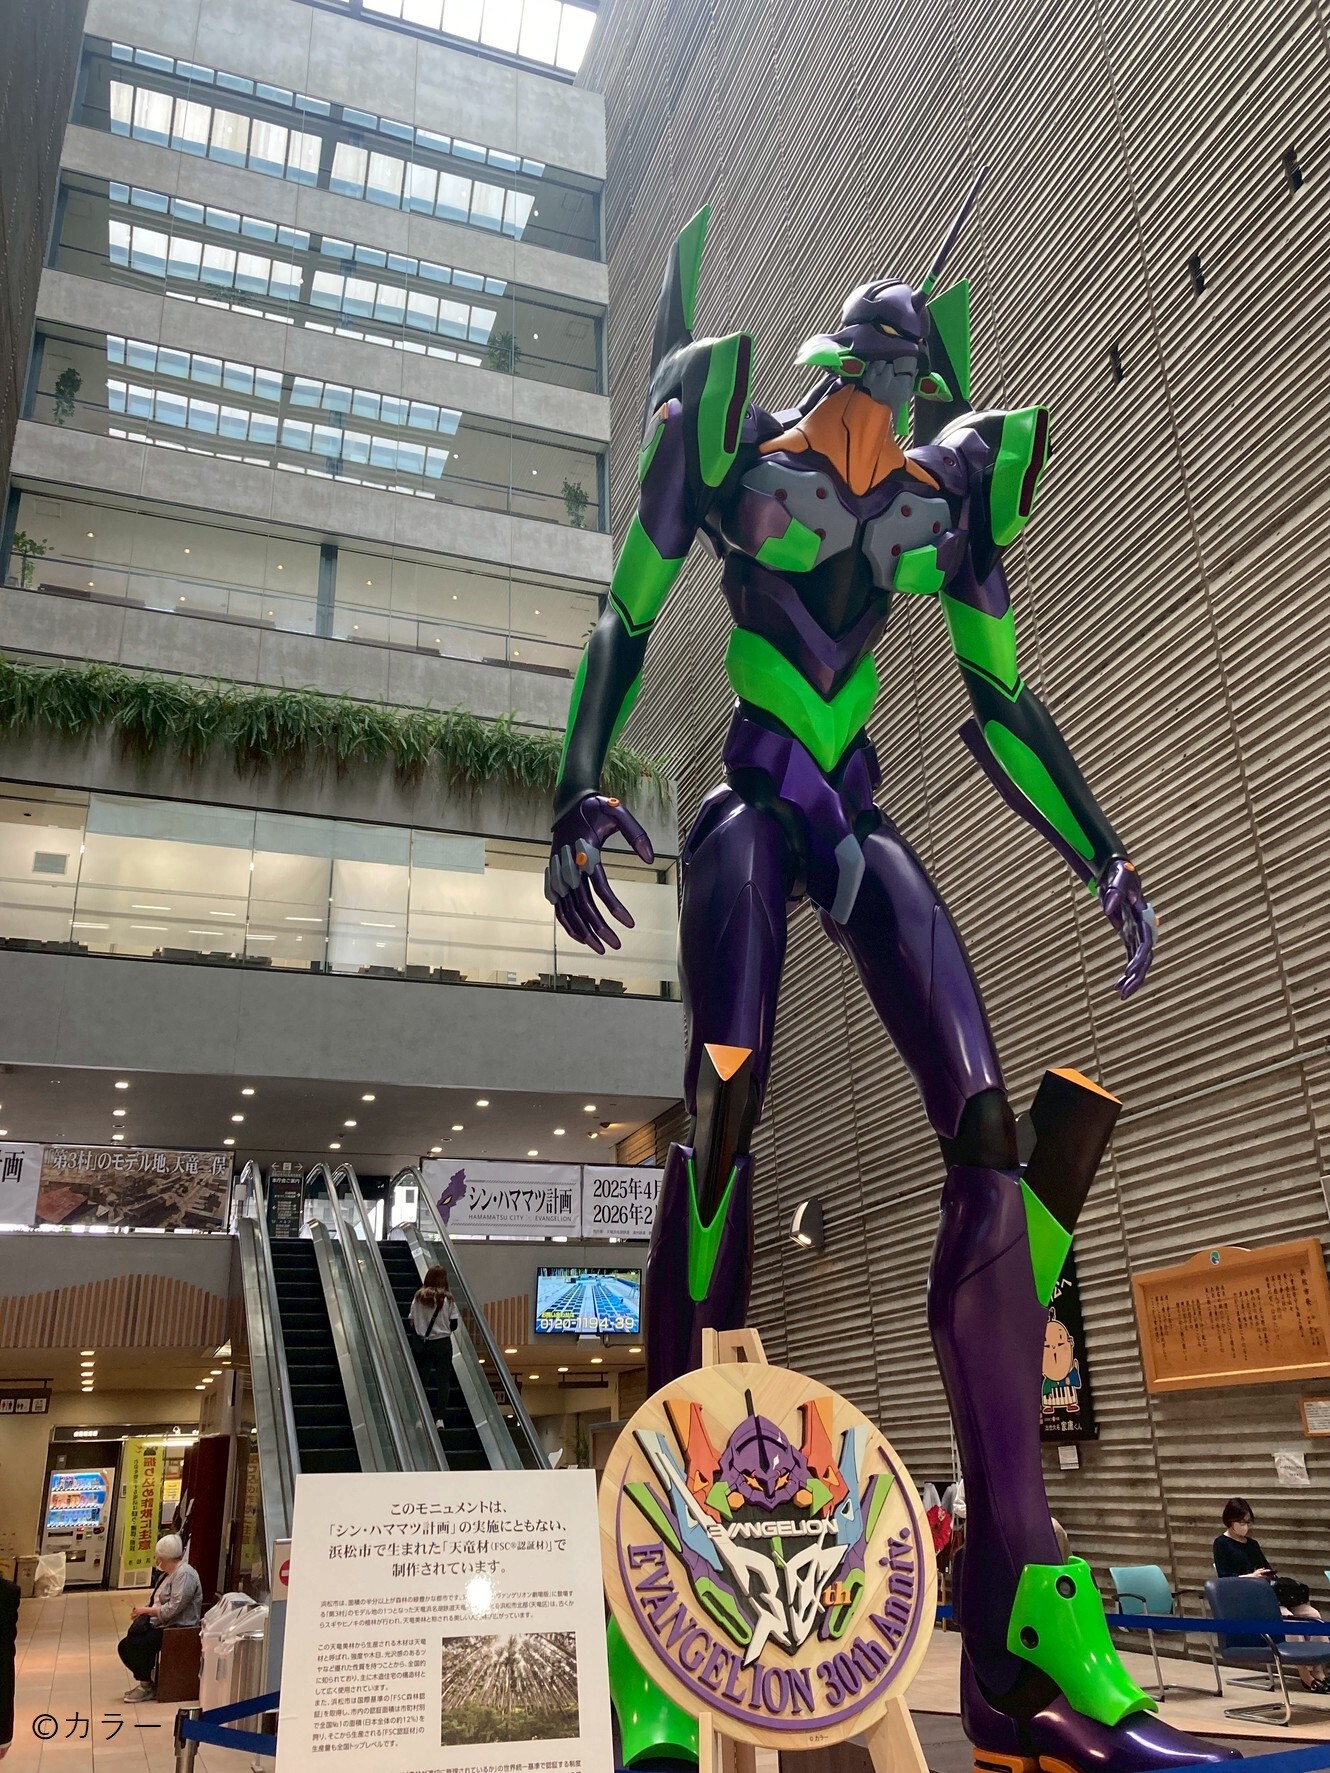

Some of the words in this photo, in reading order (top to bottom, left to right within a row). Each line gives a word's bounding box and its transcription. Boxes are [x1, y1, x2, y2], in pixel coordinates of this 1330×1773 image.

[0, 1149, 25, 1182] 画
[469, 1186, 573, 1214] シン・ハママツ計画
[593, 1203, 658, 1225] 2026年2
[540, 1317, 635, 1330] 0120-1194-39
[391, 1501, 507, 1516] このモニュメントは、
[329, 1519, 567, 1537] 「シン・ハママツ計画」の実施にともない、
[707, 1518, 839, 1539] EVANGELION
[392, 1560, 506, 1578] 制作されています。
[627, 1541, 816, 1716] EVANGELION
[816, 1637, 890, 1707] 30th
[868, 1527, 916, 1658] Anniv.
